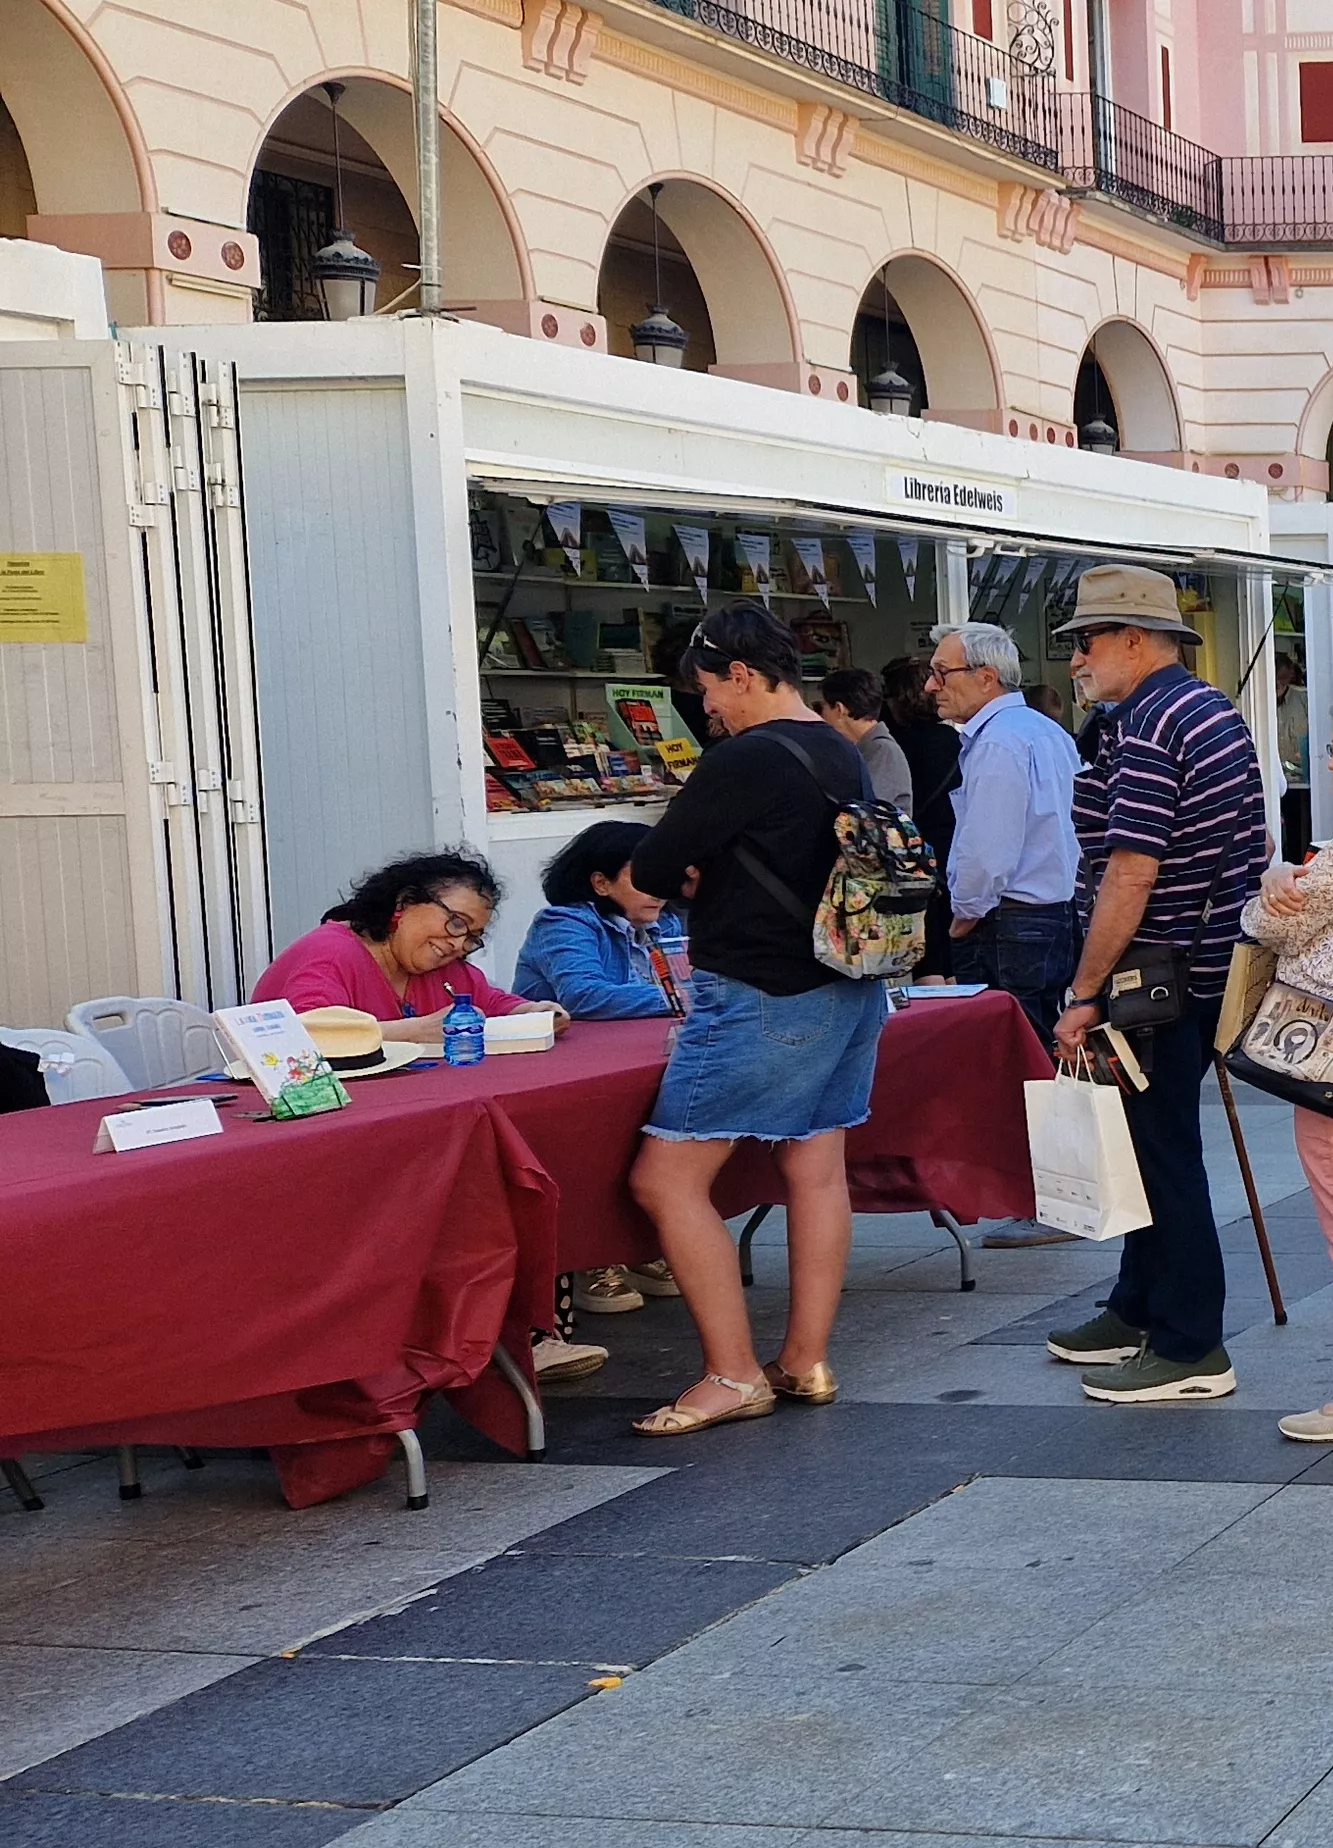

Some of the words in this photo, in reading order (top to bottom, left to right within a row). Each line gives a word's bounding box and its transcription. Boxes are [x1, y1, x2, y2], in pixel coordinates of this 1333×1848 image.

[904, 477, 951, 504] Librería
[953, 484, 1003, 512] Edelweis
[612, 688, 630, 698] HOY
[632, 689, 664, 699] FIRMAN
[665, 742, 684, 753] HOY
